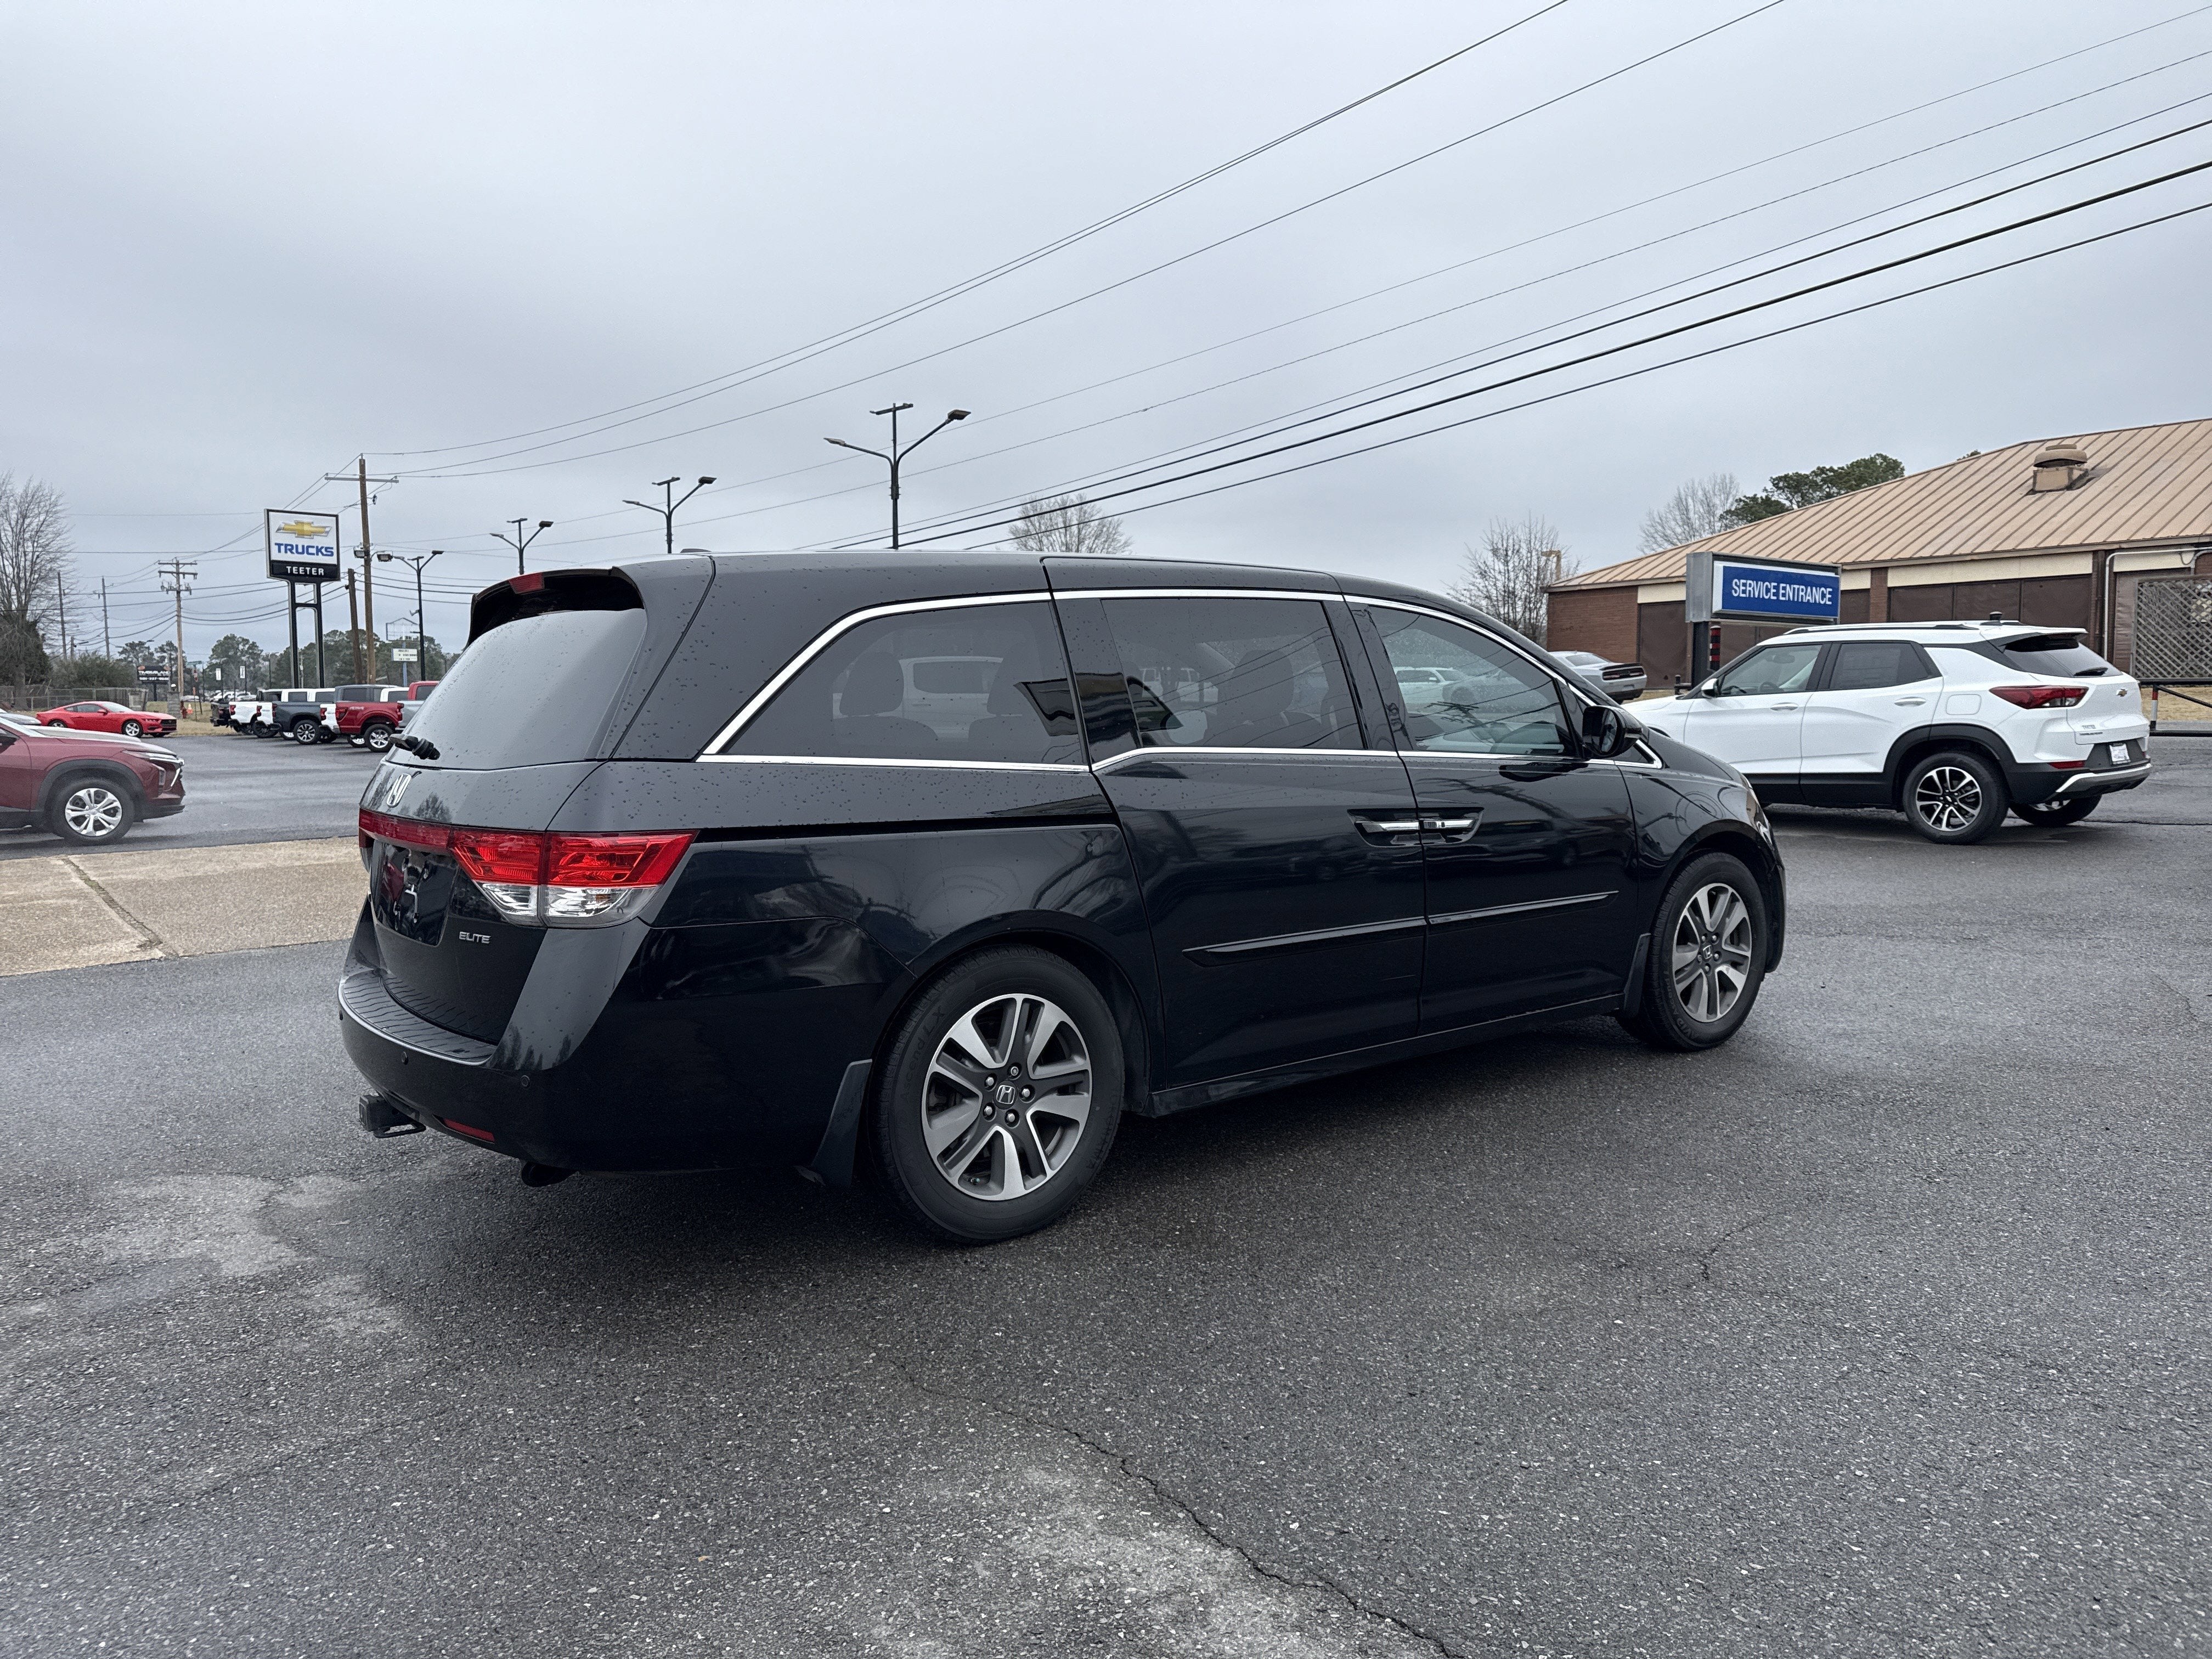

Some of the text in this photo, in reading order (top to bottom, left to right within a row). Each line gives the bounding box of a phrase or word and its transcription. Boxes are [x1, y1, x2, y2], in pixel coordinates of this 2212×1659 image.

[274, 542, 334, 557] TRUCKS
[286, 566, 324, 576] TEETER
[1731, 578, 1833, 605] SERVICE ENTRANCE
[459, 931, 492, 944] ELITE
